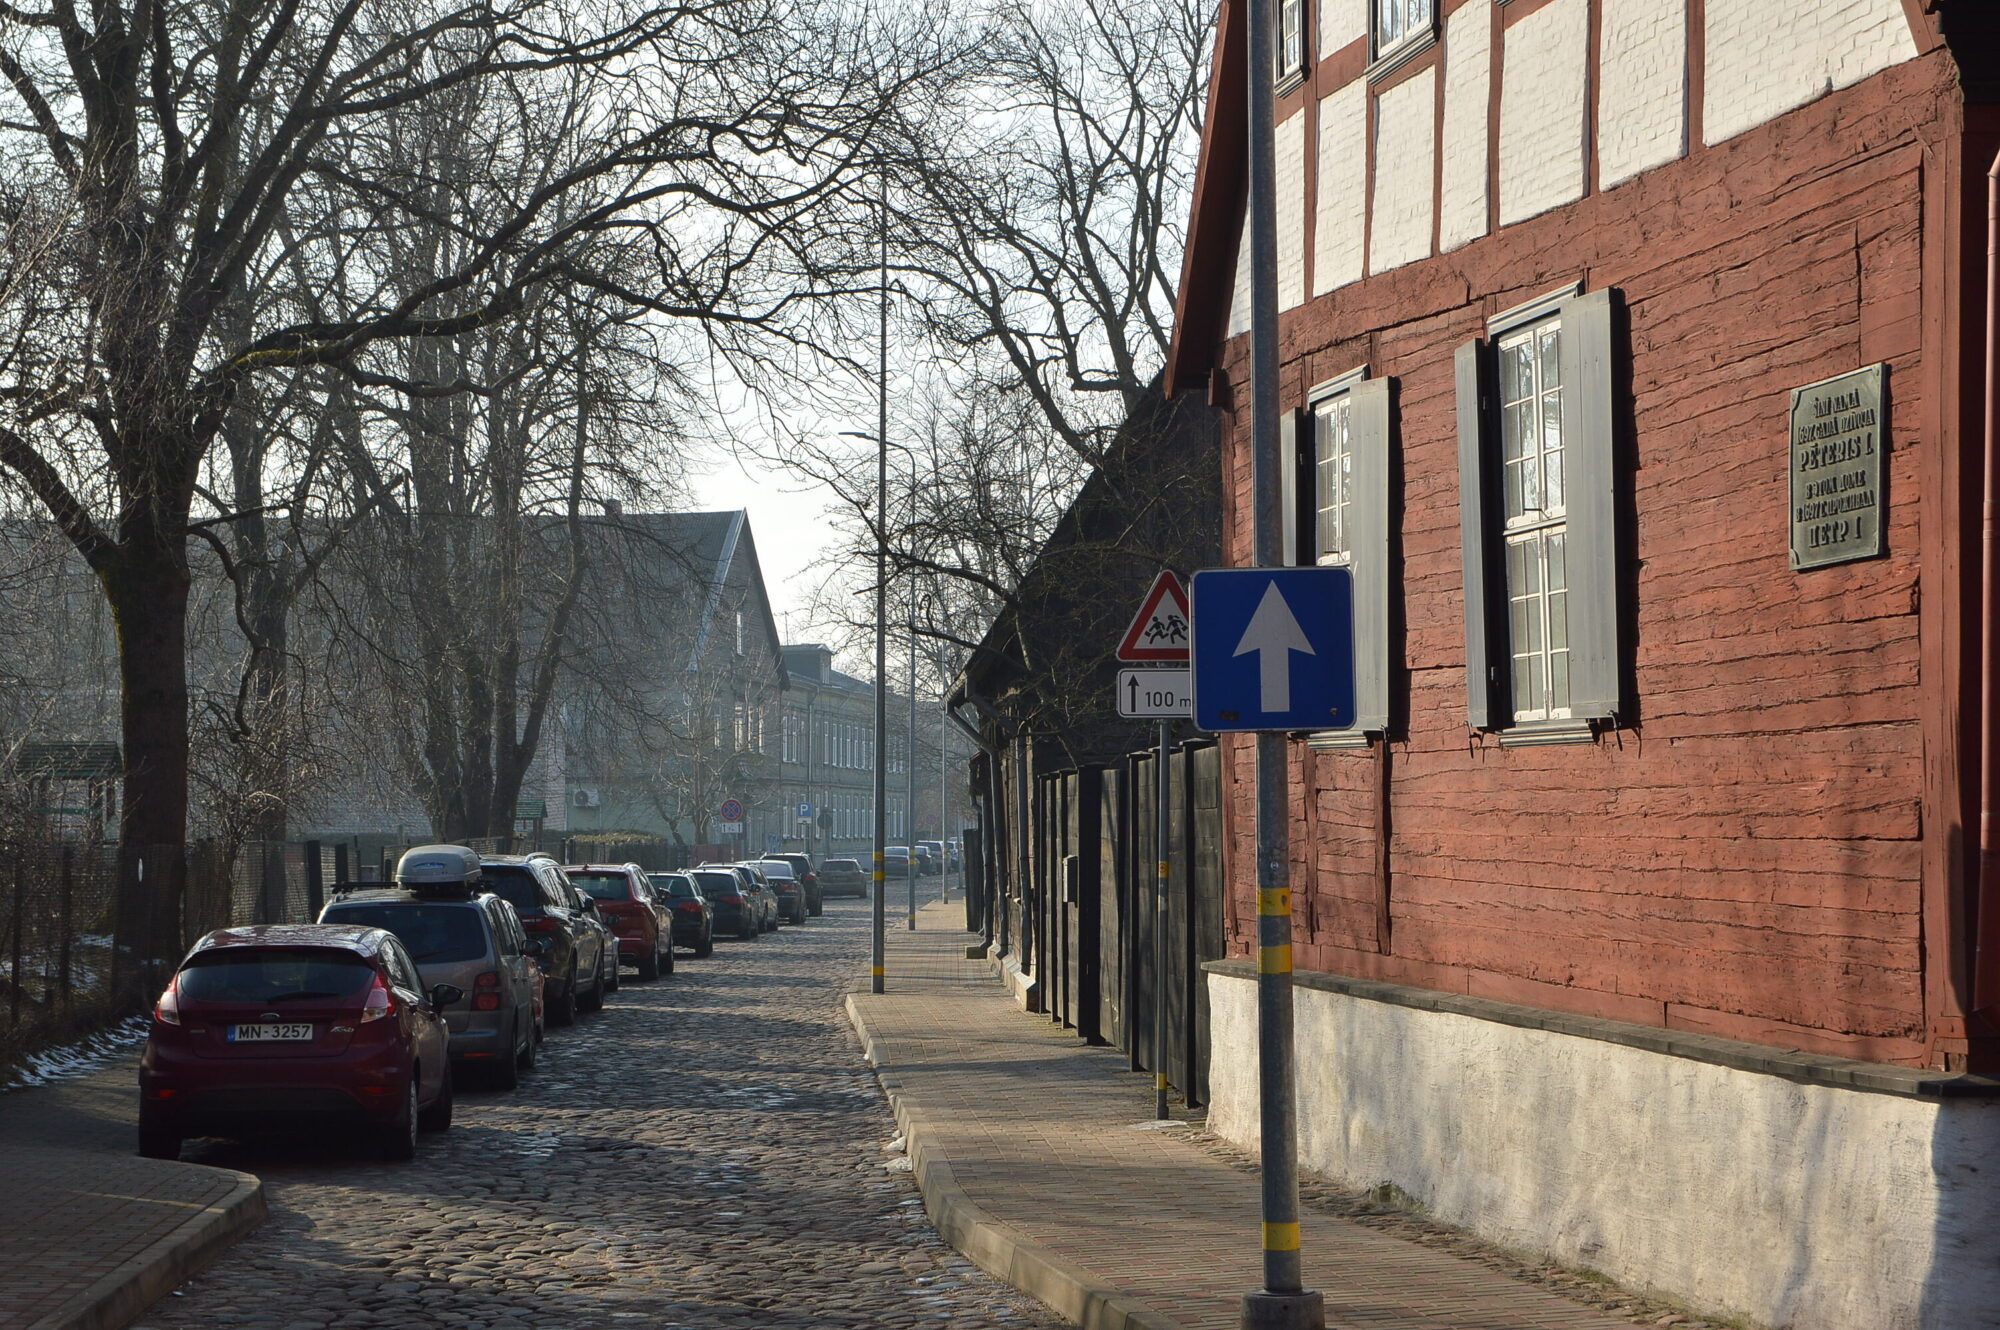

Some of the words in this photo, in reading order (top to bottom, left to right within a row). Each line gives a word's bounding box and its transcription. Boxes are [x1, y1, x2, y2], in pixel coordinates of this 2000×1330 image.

[1816, 416, 1839, 439] GADĀ
[1800, 436, 1861, 472] PĒTERIS
[1840, 470, 1866, 492] ДОМЕ
[1809, 520, 1849, 548] ПЕТР
[1145, 691, 1174, 707] 100
[1179, 698, 1191, 707] m
[800, 804, 809, 816] P
